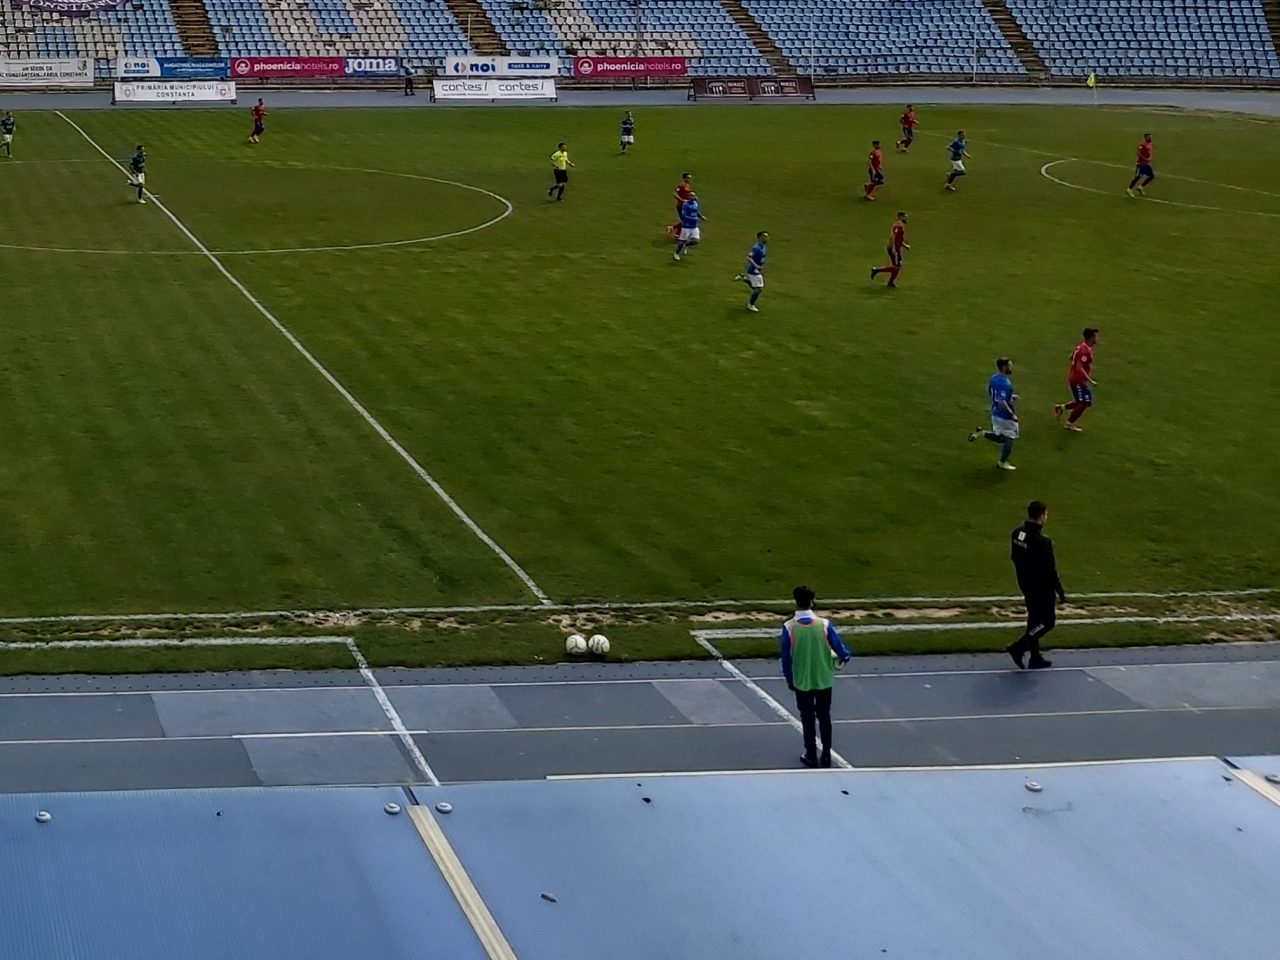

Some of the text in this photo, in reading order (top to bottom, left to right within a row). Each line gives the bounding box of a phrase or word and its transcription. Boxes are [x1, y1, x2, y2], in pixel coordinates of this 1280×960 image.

[133, 60, 150, 69] noi
[254, 60, 339, 72] phoeniciahotels.ro
[470, 58, 496, 73] noi
[597, 61, 682, 72] phoeniciahotels.ro
